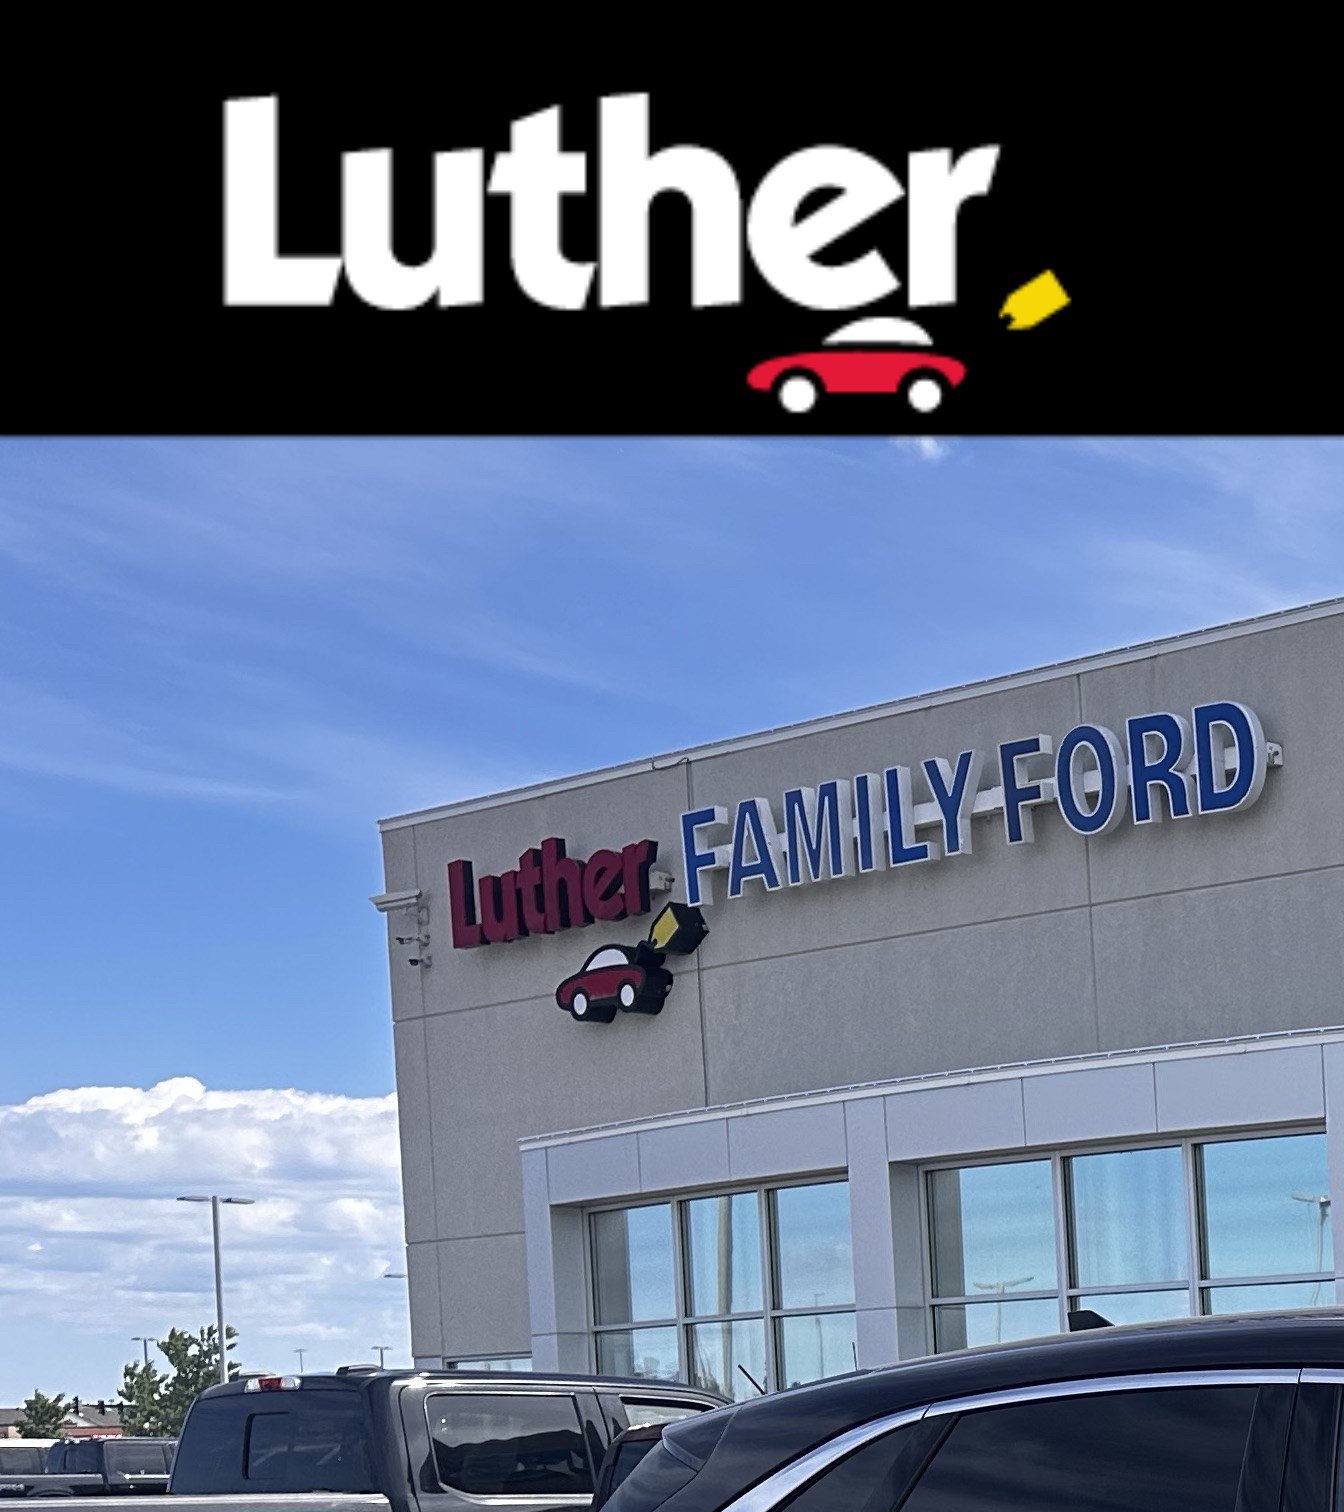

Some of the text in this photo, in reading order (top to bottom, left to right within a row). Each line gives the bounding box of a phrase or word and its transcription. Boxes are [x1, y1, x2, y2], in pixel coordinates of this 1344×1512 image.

[681, 700, 1268, 908] FAMILY FORD
[447, 836, 658, 949] Luther
